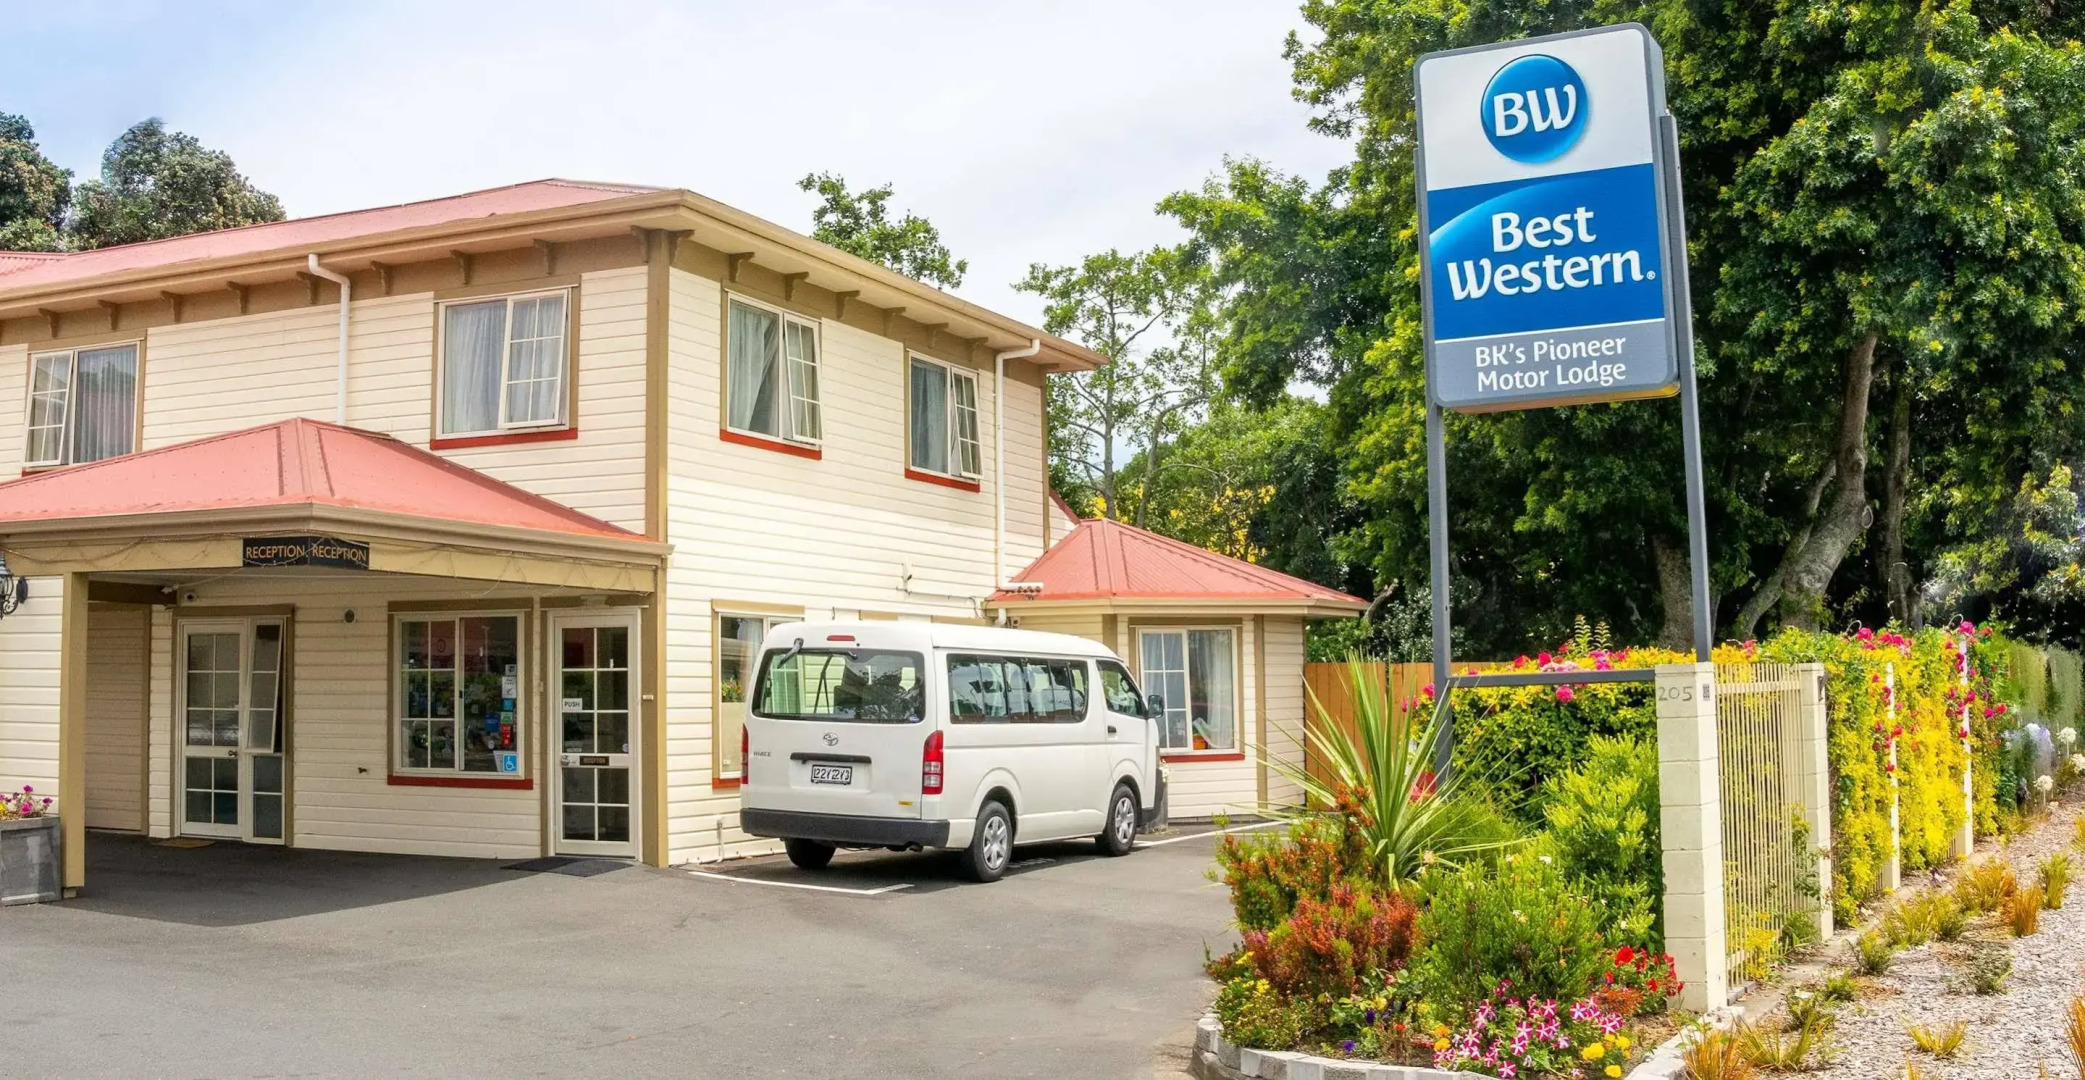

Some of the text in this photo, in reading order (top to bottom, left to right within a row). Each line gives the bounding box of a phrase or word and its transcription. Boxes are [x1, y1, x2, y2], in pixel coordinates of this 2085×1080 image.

[1493, 84, 1577, 137] BW
[1491, 206, 1597, 253] Best
[1475, 336, 1626, 368] BK's Pioneer
[1477, 360, 1627, 393] Motor Lodge
[246, 545, 367, 560] RECEPTION RECEPTION
[1658, 686, 1694, 702] 205
